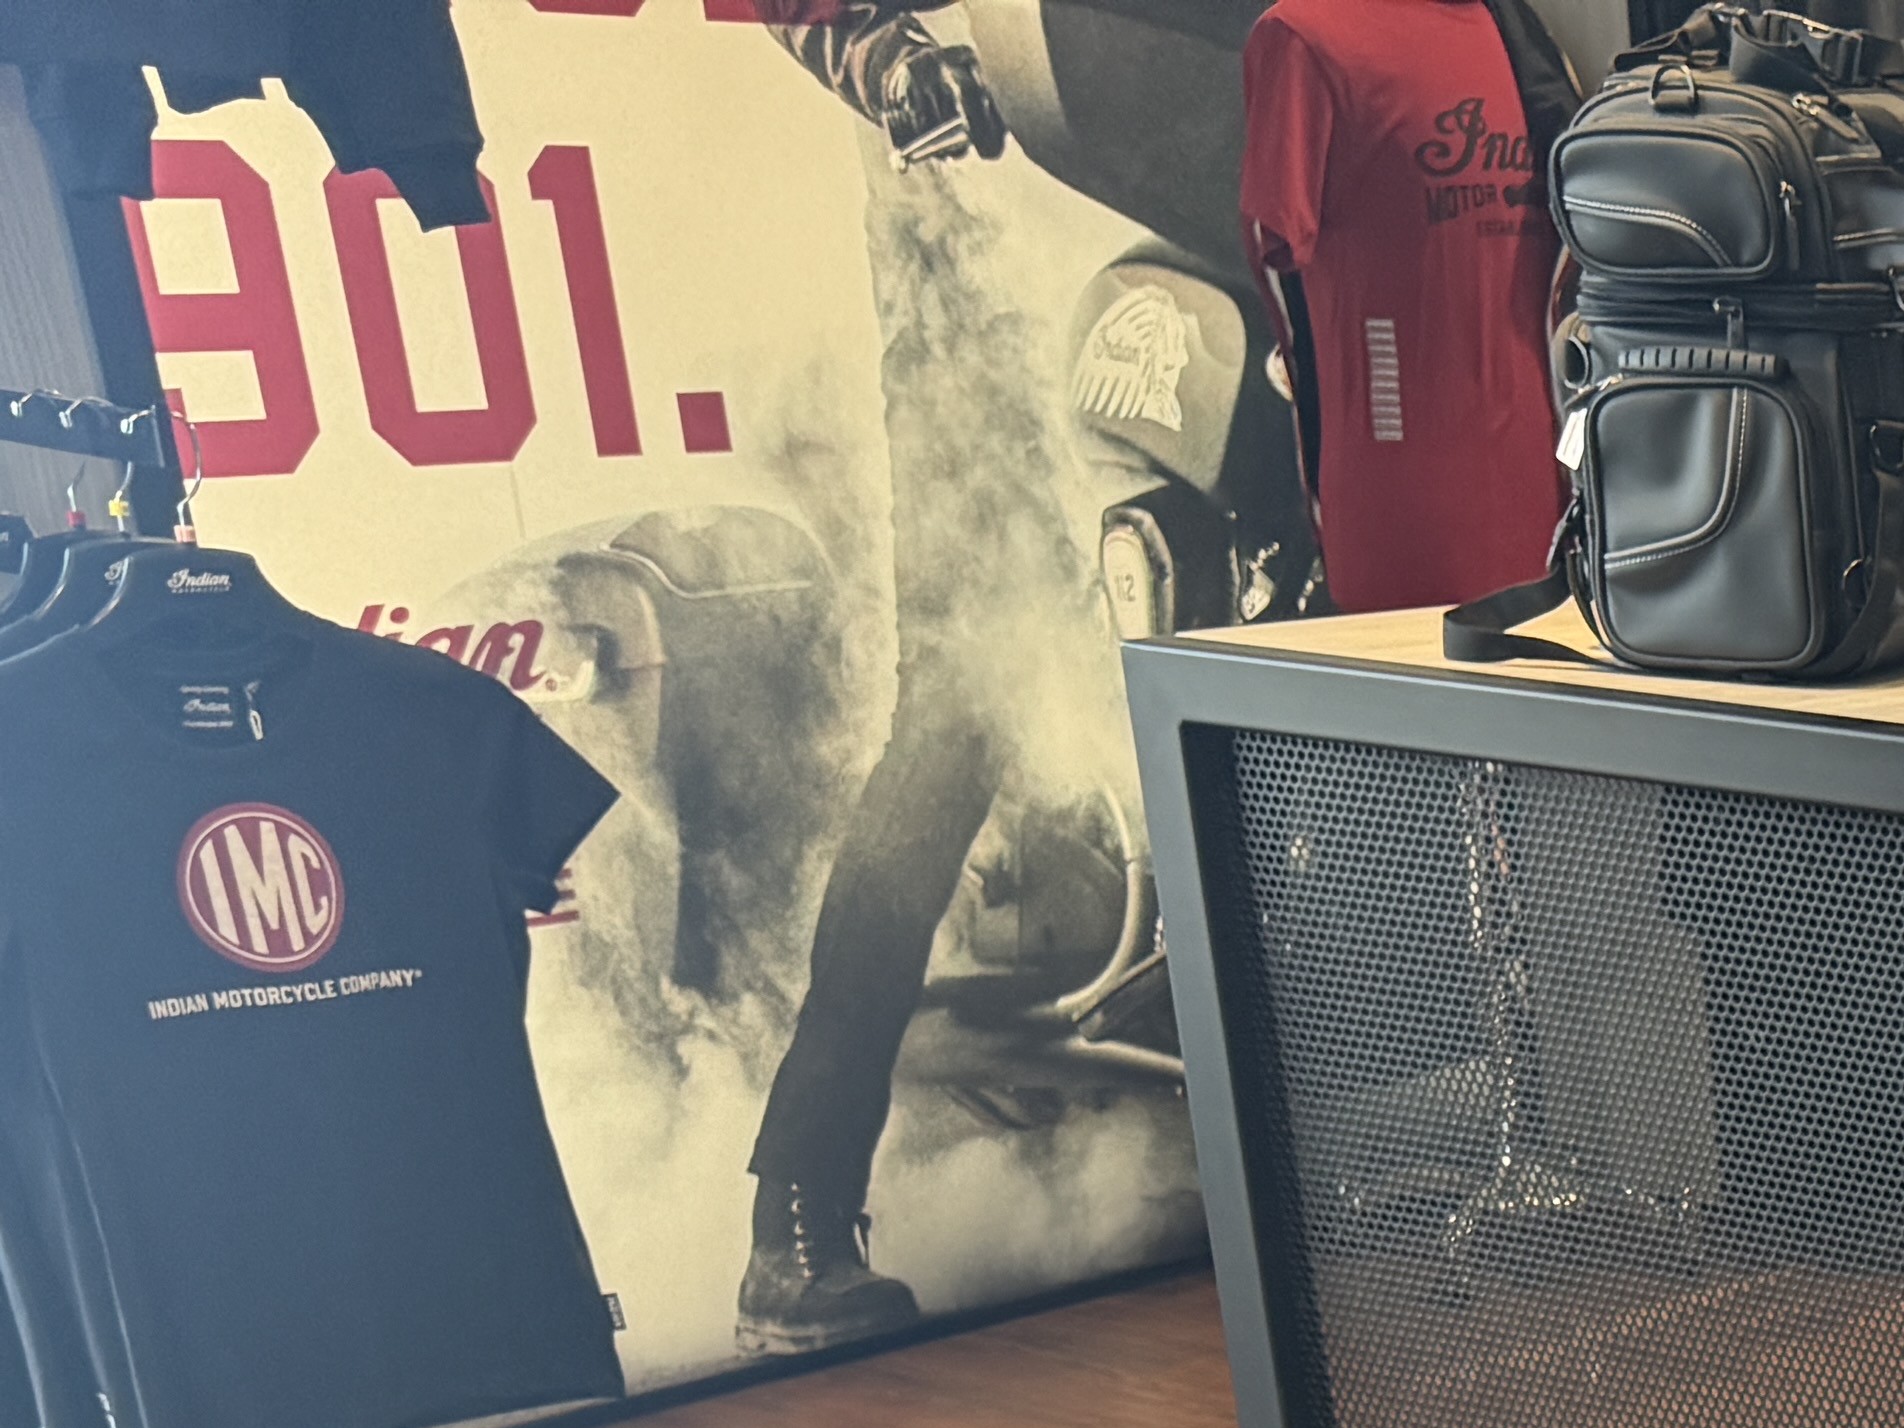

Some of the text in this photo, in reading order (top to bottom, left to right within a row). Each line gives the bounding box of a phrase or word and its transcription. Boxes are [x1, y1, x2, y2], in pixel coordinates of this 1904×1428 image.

[166, 568, 232, 588] Indian
[199, 821, 329, 954] IMC
[148, 969, 415, 1020] INDIAN MOTORCYCLE COMPANY
